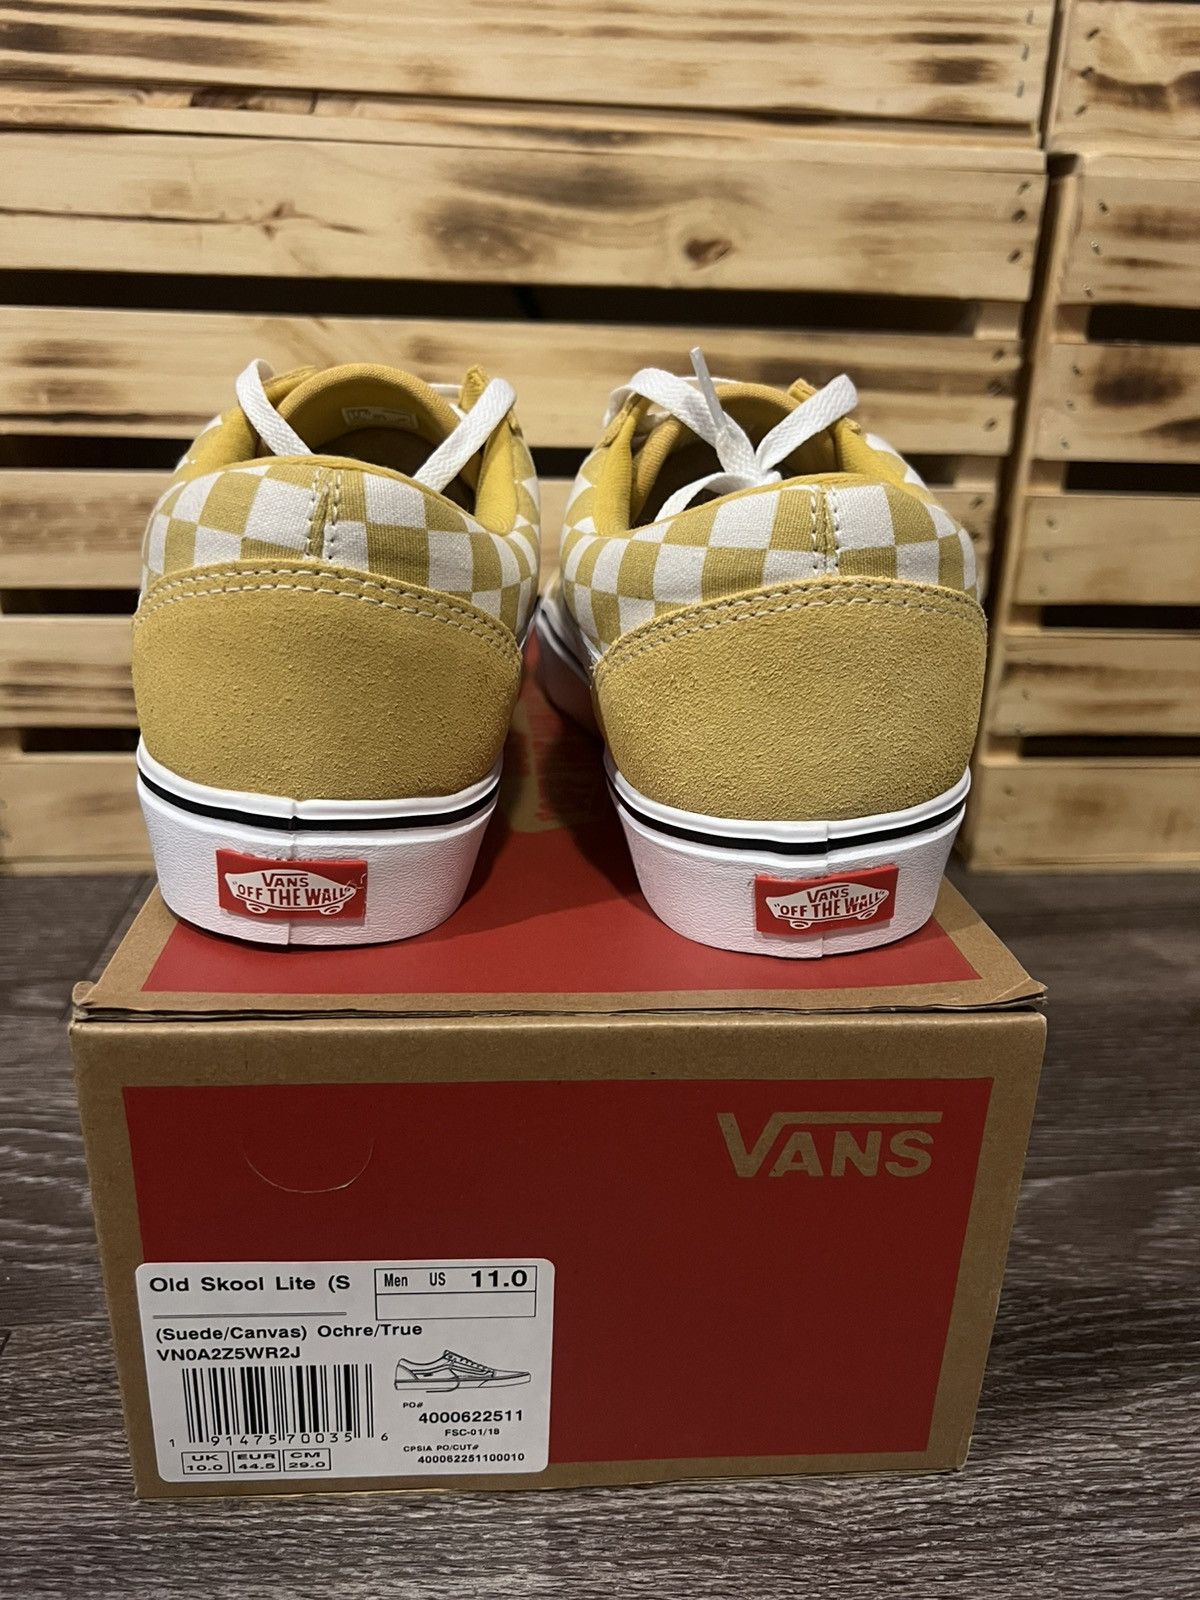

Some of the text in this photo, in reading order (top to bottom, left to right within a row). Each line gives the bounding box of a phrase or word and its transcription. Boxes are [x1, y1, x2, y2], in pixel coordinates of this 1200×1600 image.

[261, 872, 309, 888] VANS
[268, 888, 301, 906] THE
[806, 884, 850, 904] VANS
[812, 899, 840, 918] THE
[716, 1111, 944, 1178] VANS
[149, 1274, 351, 1293] Old Skool Lite (S
[384, 1269, 528, 1288] Men US 11.0
[156, 1322, 423, 1344] (Suede/Canvas) Ochre/True
[156, 1346, 301, 1362] VN0A2Z5WR2J
[402, 1401, 423, 1409] PO#
[418, 1409, 523, 1424] 4000622511
[444, 1427, 500, 1437] FSC-01/18
[290, 1451, 321, 1459] CM
[403, 1444, 479, 1453] CPSIA PO/CUT#
[191, 1454, 220, 1462] UK
[236, 1453, 276, 1461] EUR
[417, 1453, 525, 1464] 400062251100010
[186, 1463, 224, 1472] 10.0
[288, 1461, 326, 1470] 29.0
